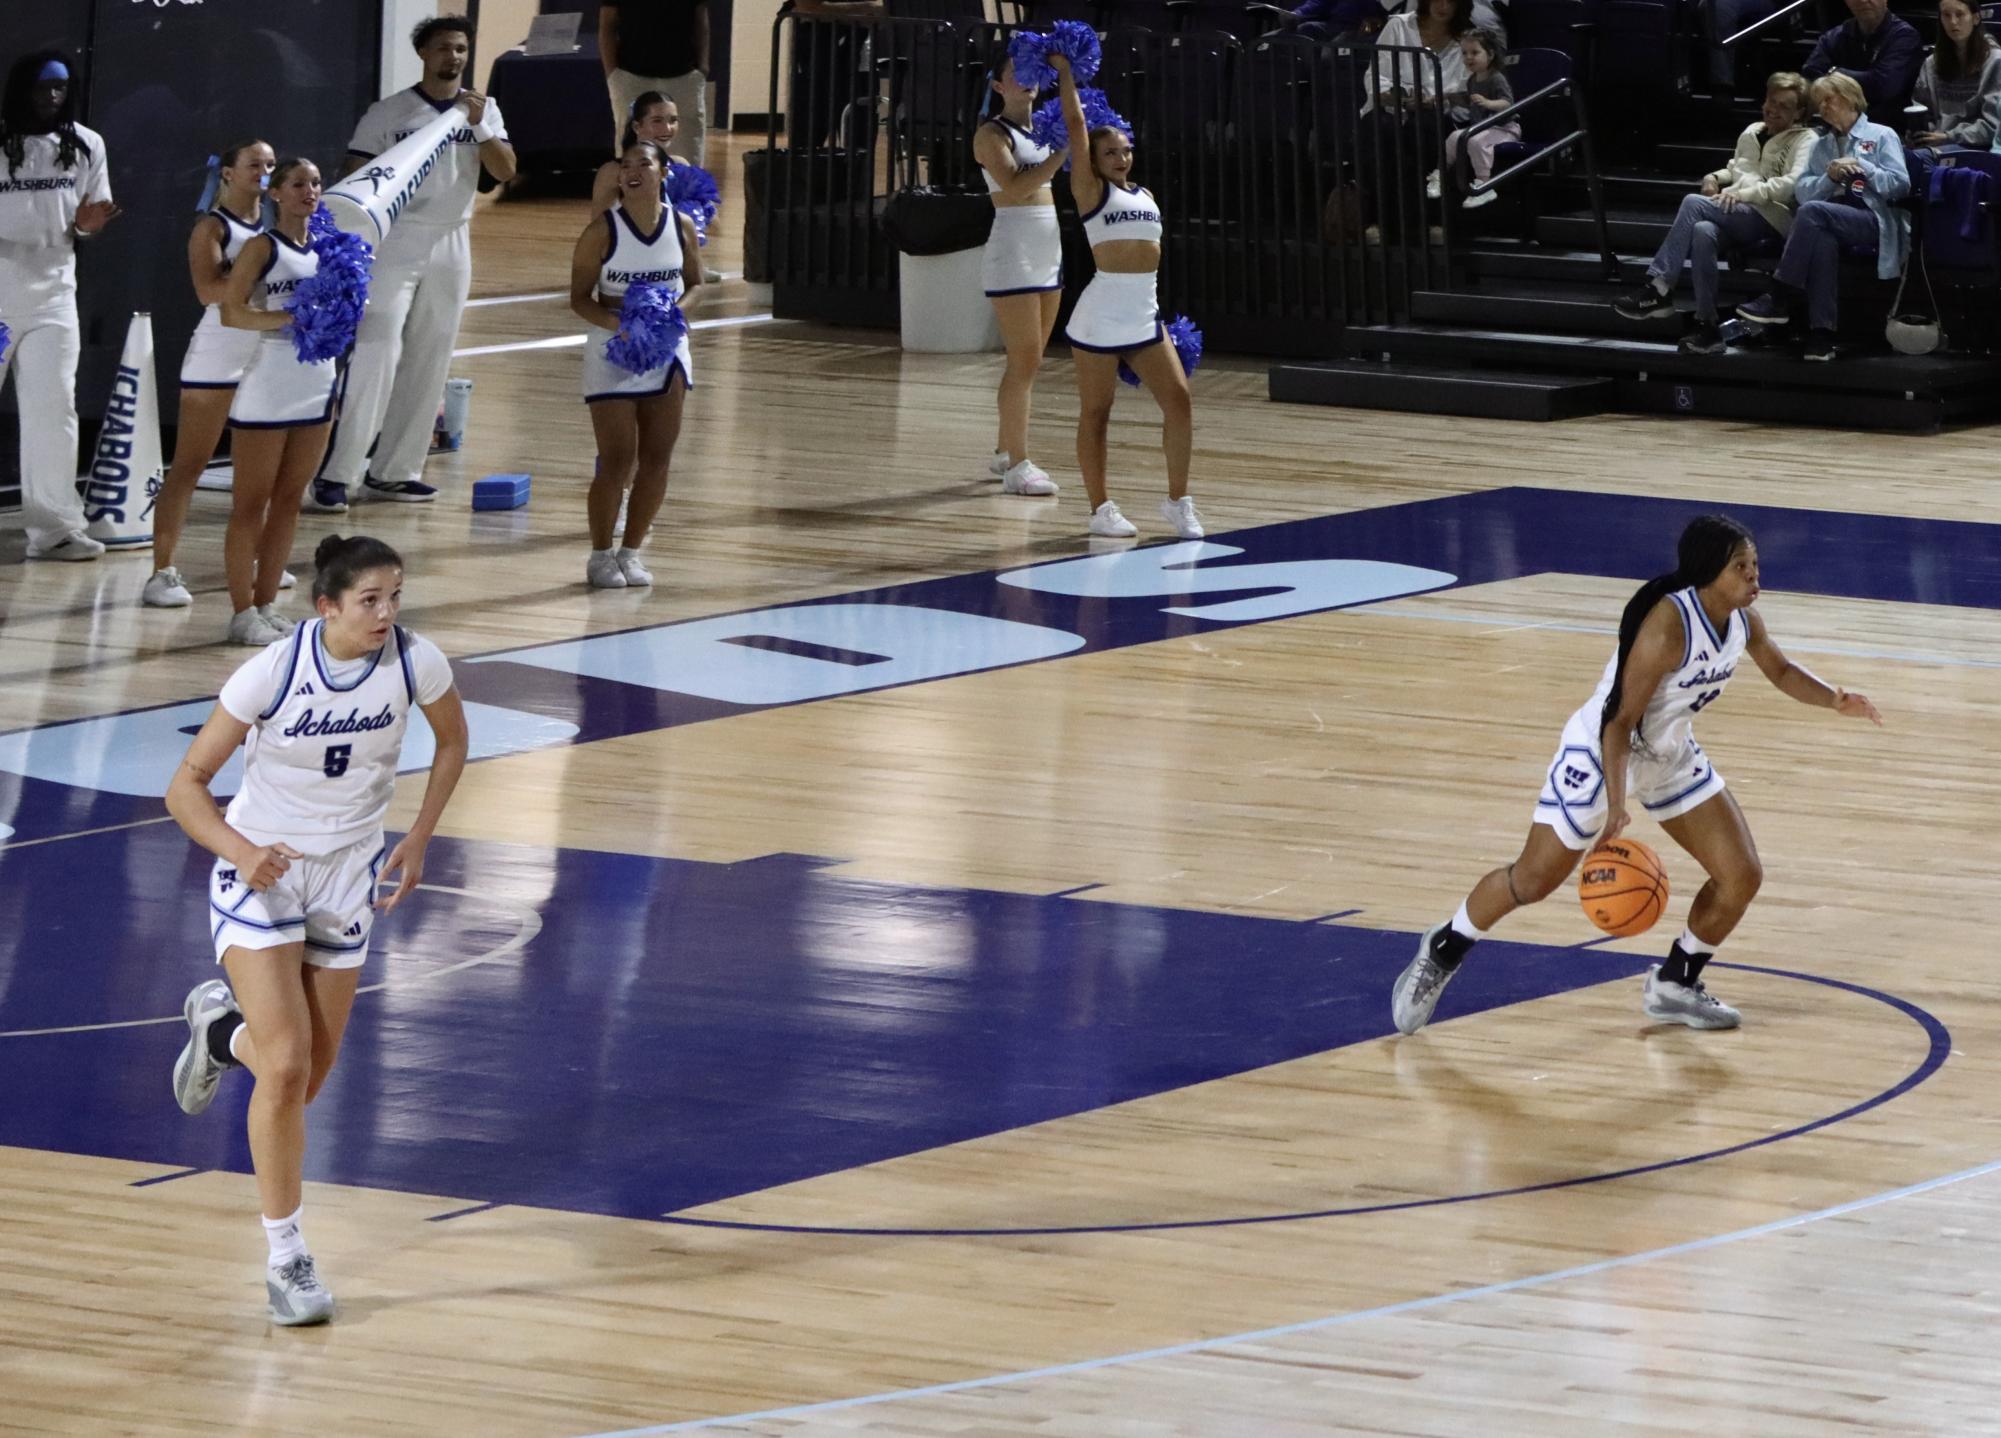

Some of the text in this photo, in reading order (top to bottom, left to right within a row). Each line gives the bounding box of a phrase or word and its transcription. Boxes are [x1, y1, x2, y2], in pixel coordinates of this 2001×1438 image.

[0, 178, 76, 193] WASHBURN
[84, 364, 140, 524] ICHABODS
[284, 703, 395, 738] Ichabods
[323, 743, 352, 778] 5
